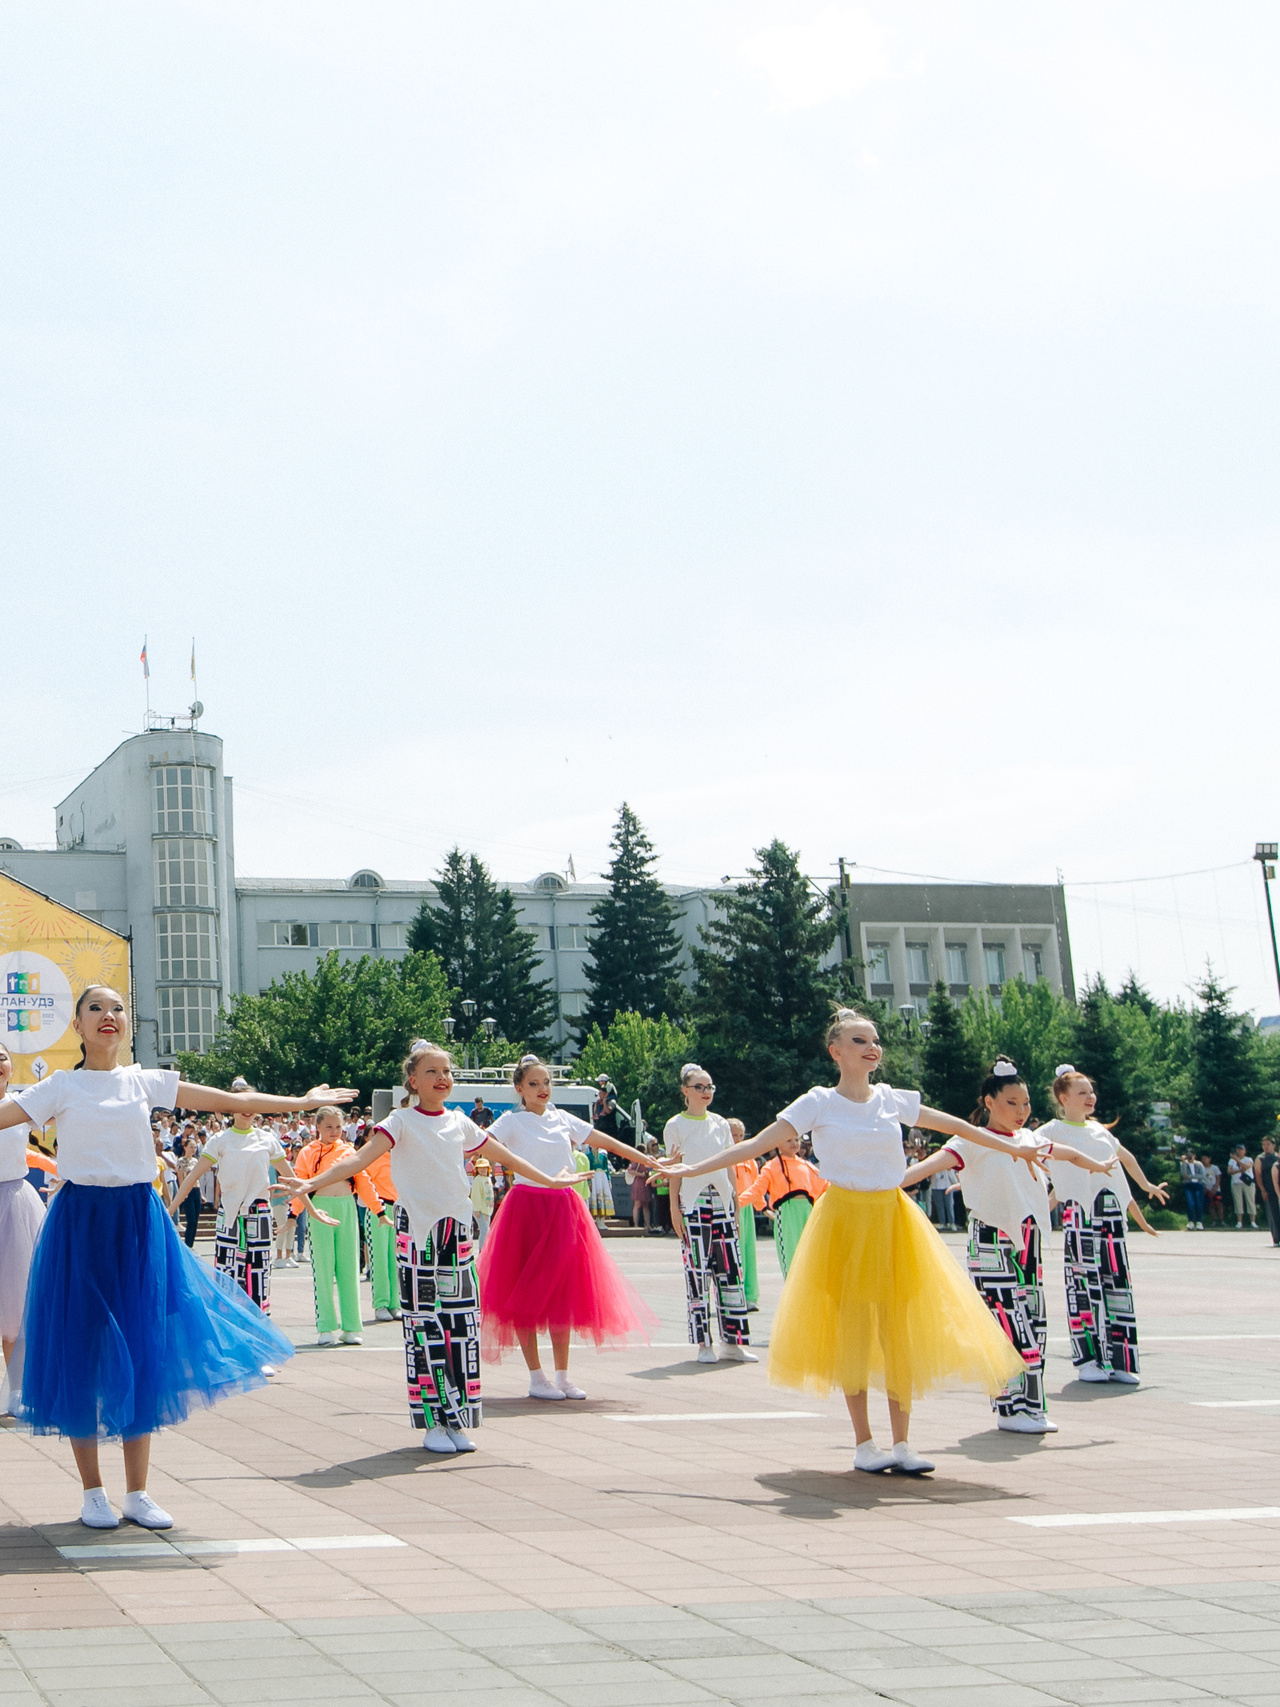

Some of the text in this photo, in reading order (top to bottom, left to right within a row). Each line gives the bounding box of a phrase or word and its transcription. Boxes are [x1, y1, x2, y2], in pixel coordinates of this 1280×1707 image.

[404, 1315, 416, 1379] DANCE
[465, 1313, 478, 1374] DANCE
[436, 1368, 447, 1405] DANCE
